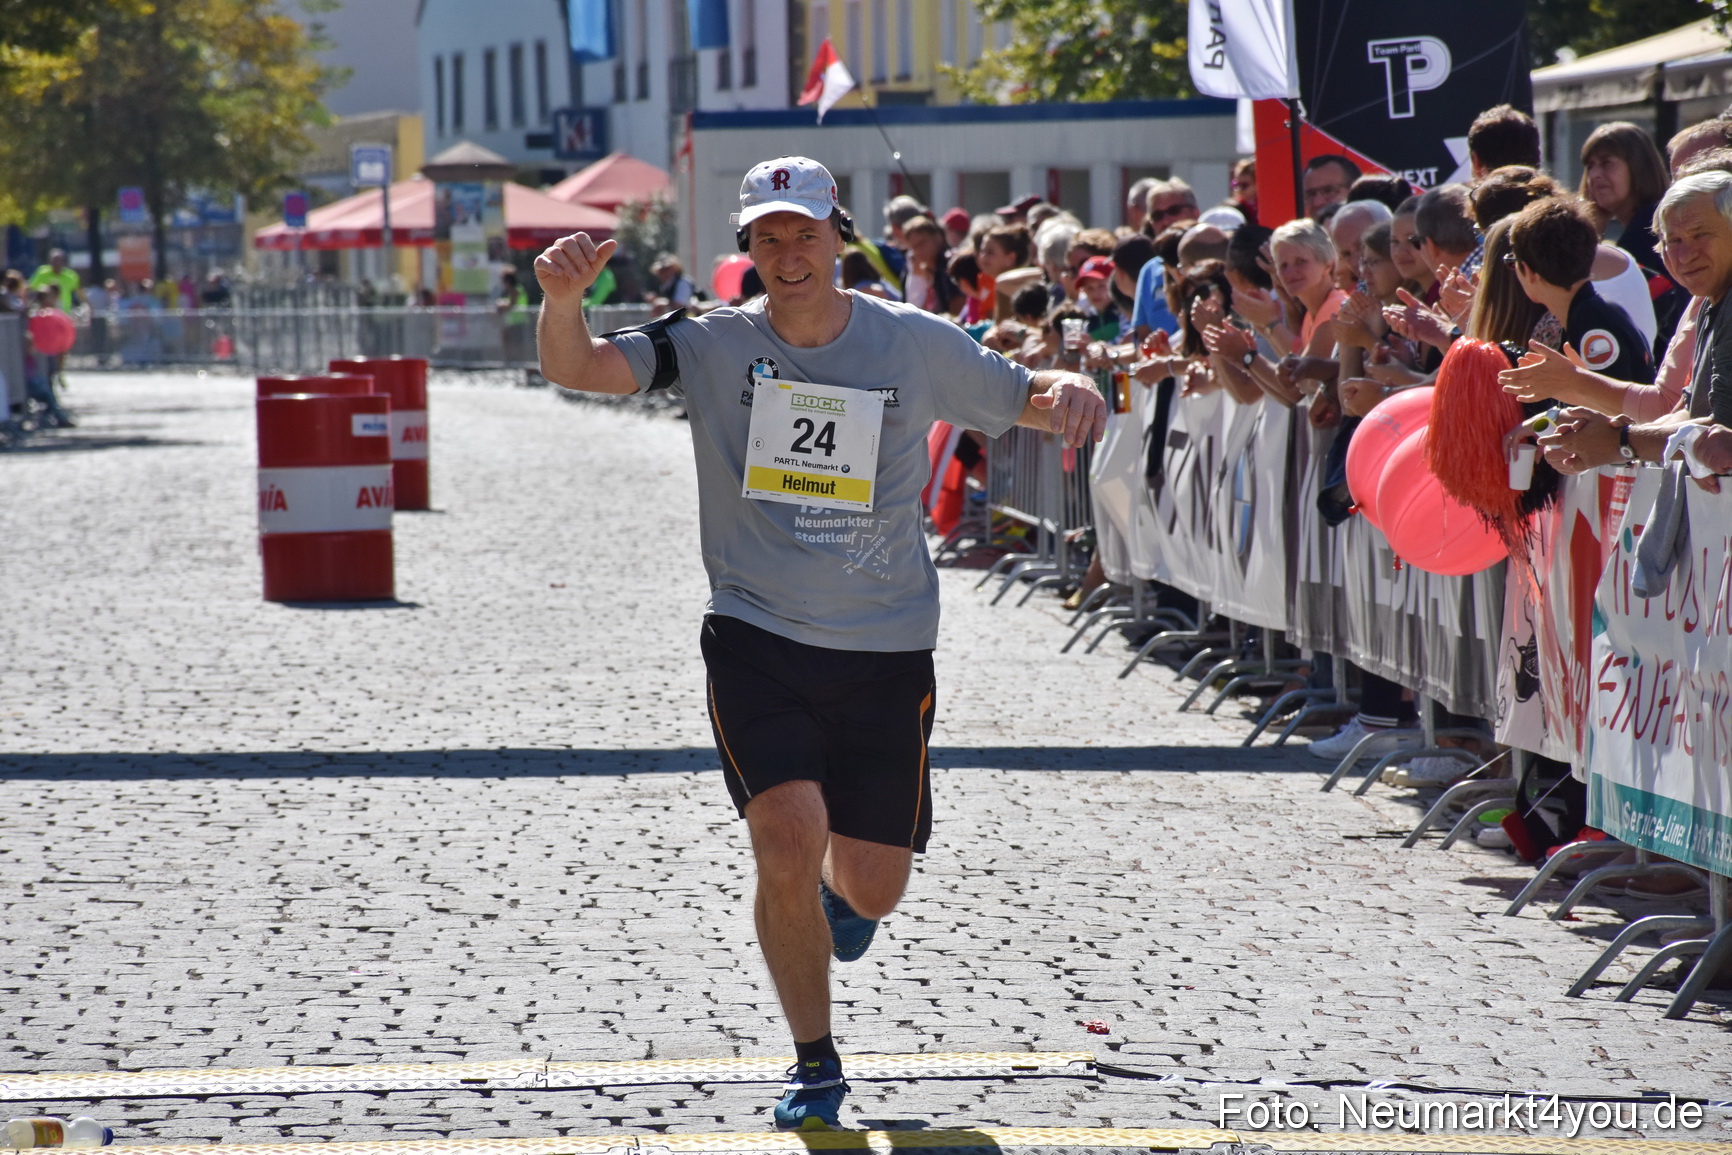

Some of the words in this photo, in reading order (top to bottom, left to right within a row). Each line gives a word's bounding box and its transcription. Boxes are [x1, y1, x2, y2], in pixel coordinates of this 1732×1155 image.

[1374, 46, 1398, 56] Team
[770, 168, 791, 191] R
[791, 393, 846, 412] BOCK
[755, 440, 761, 448] C
[790, 417, 836, 457] 24
[774, 456, 800, 467] PARTL
[802, 460, 839, 472] Neumarkt
[782, 474, 836, 495] Helmut
[795, 516, 875, 528] Neumarkter
[872, 535, 886, 550] 2018
